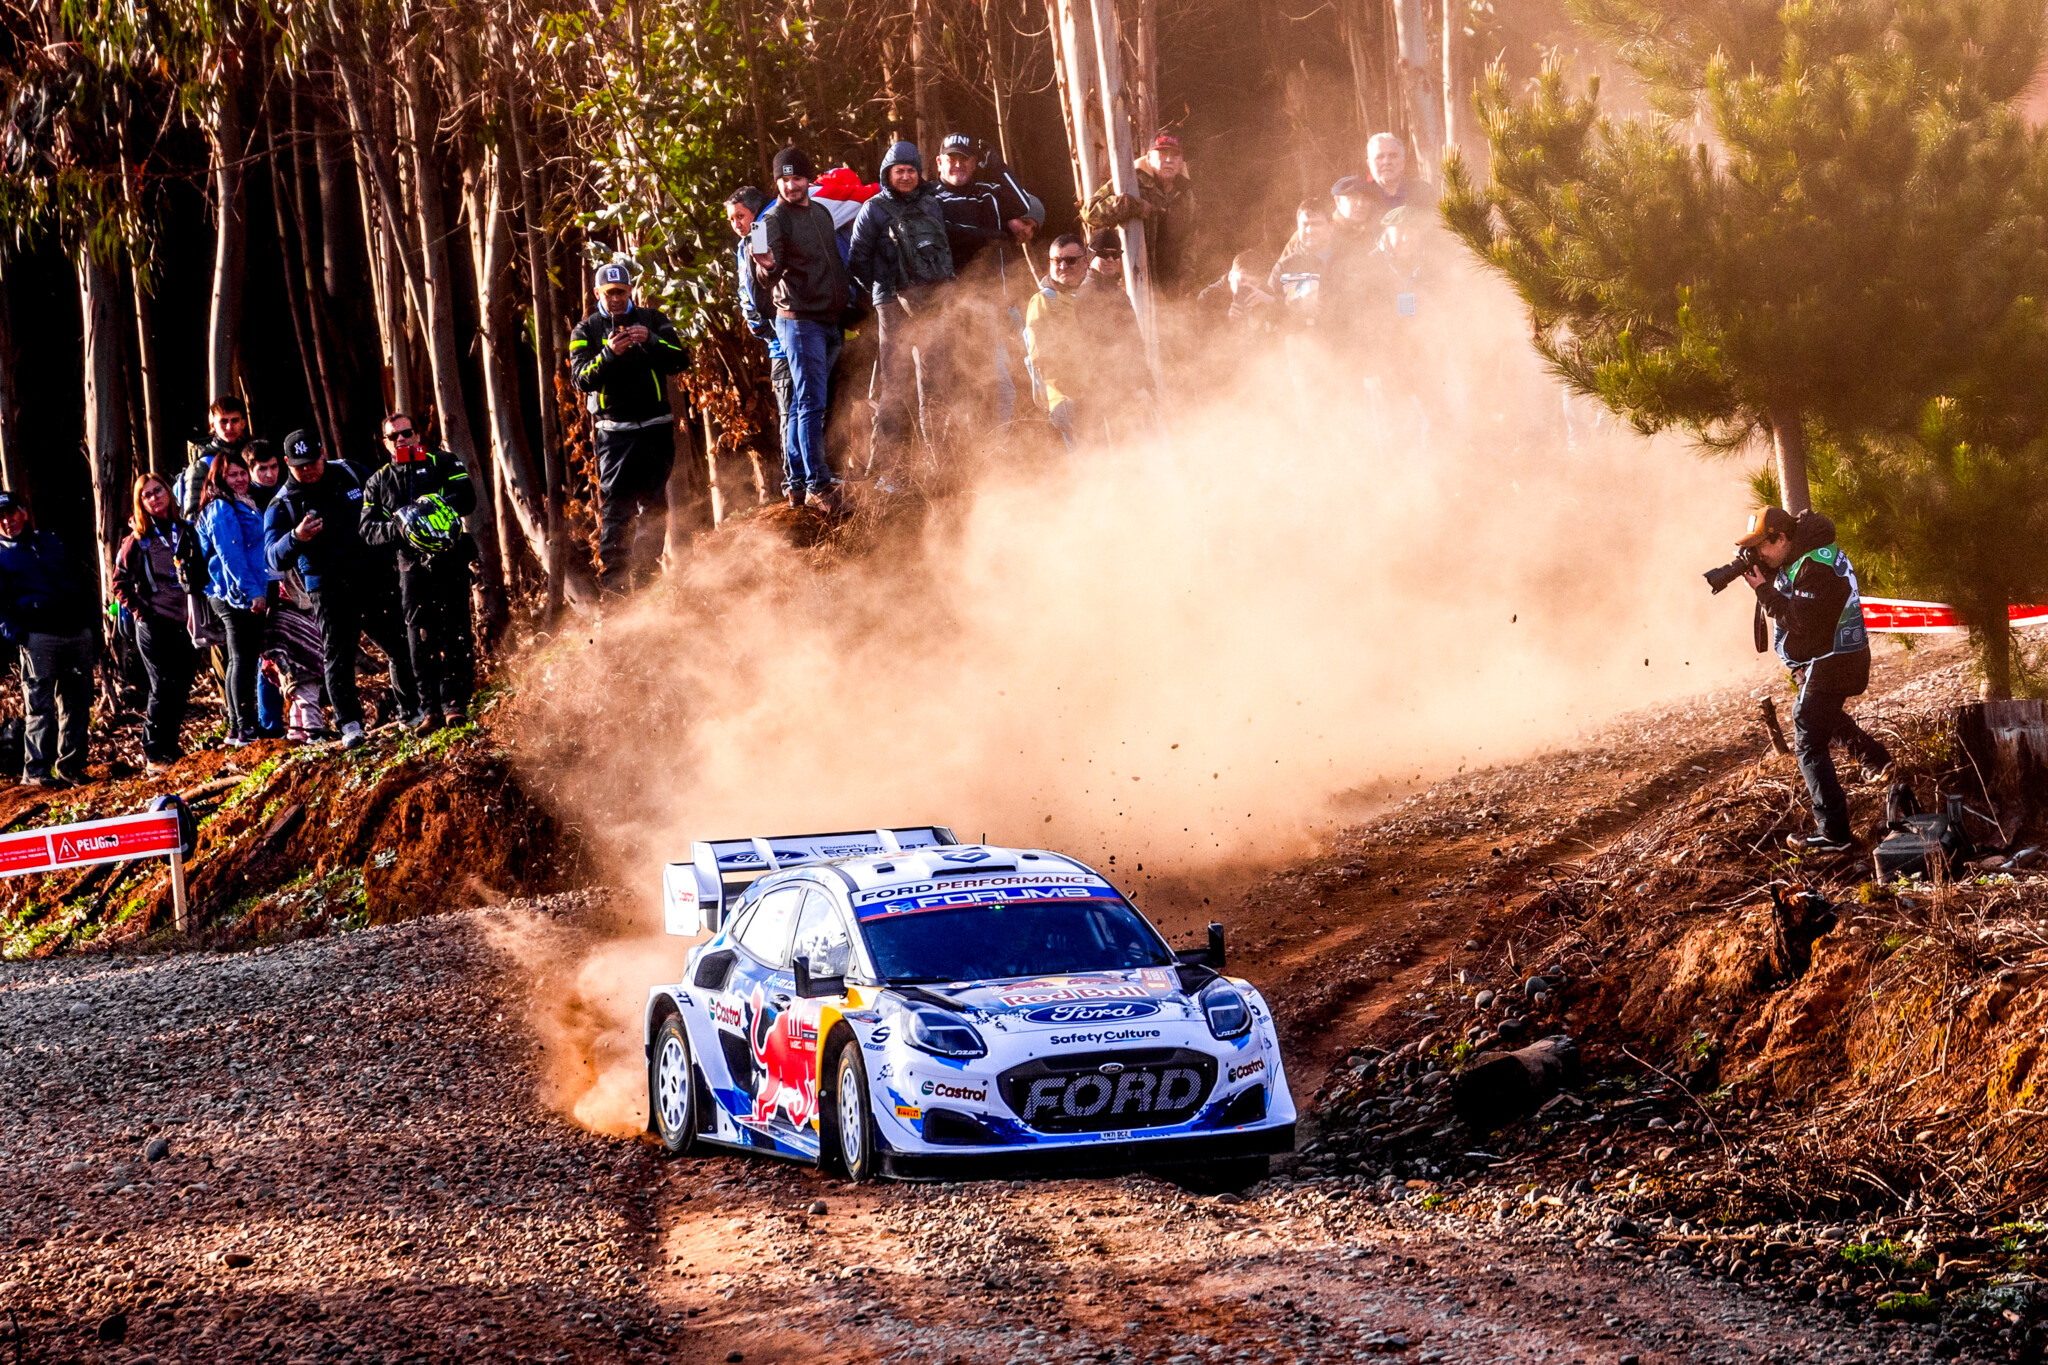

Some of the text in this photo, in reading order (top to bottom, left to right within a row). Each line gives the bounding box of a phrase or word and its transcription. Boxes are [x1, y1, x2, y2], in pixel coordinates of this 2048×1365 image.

[861, 876, 1096, 902] FORD PERFORMANCE
[916, 887, 1092, 908] FORUM8
[1001, 985, 1150, 1007] Red Bull
[715, 1001, 742, 1027] Castrol
[1051, 1003, 1135, 1021] Ford
[1050, 1029, 1161, 1044] SafetyCulture
[1236, 1058, 1265, 1079] Castrol
[935, 1083, 987, 1102] Castrol
[1022, 1069, 1202, 1120] FORD
